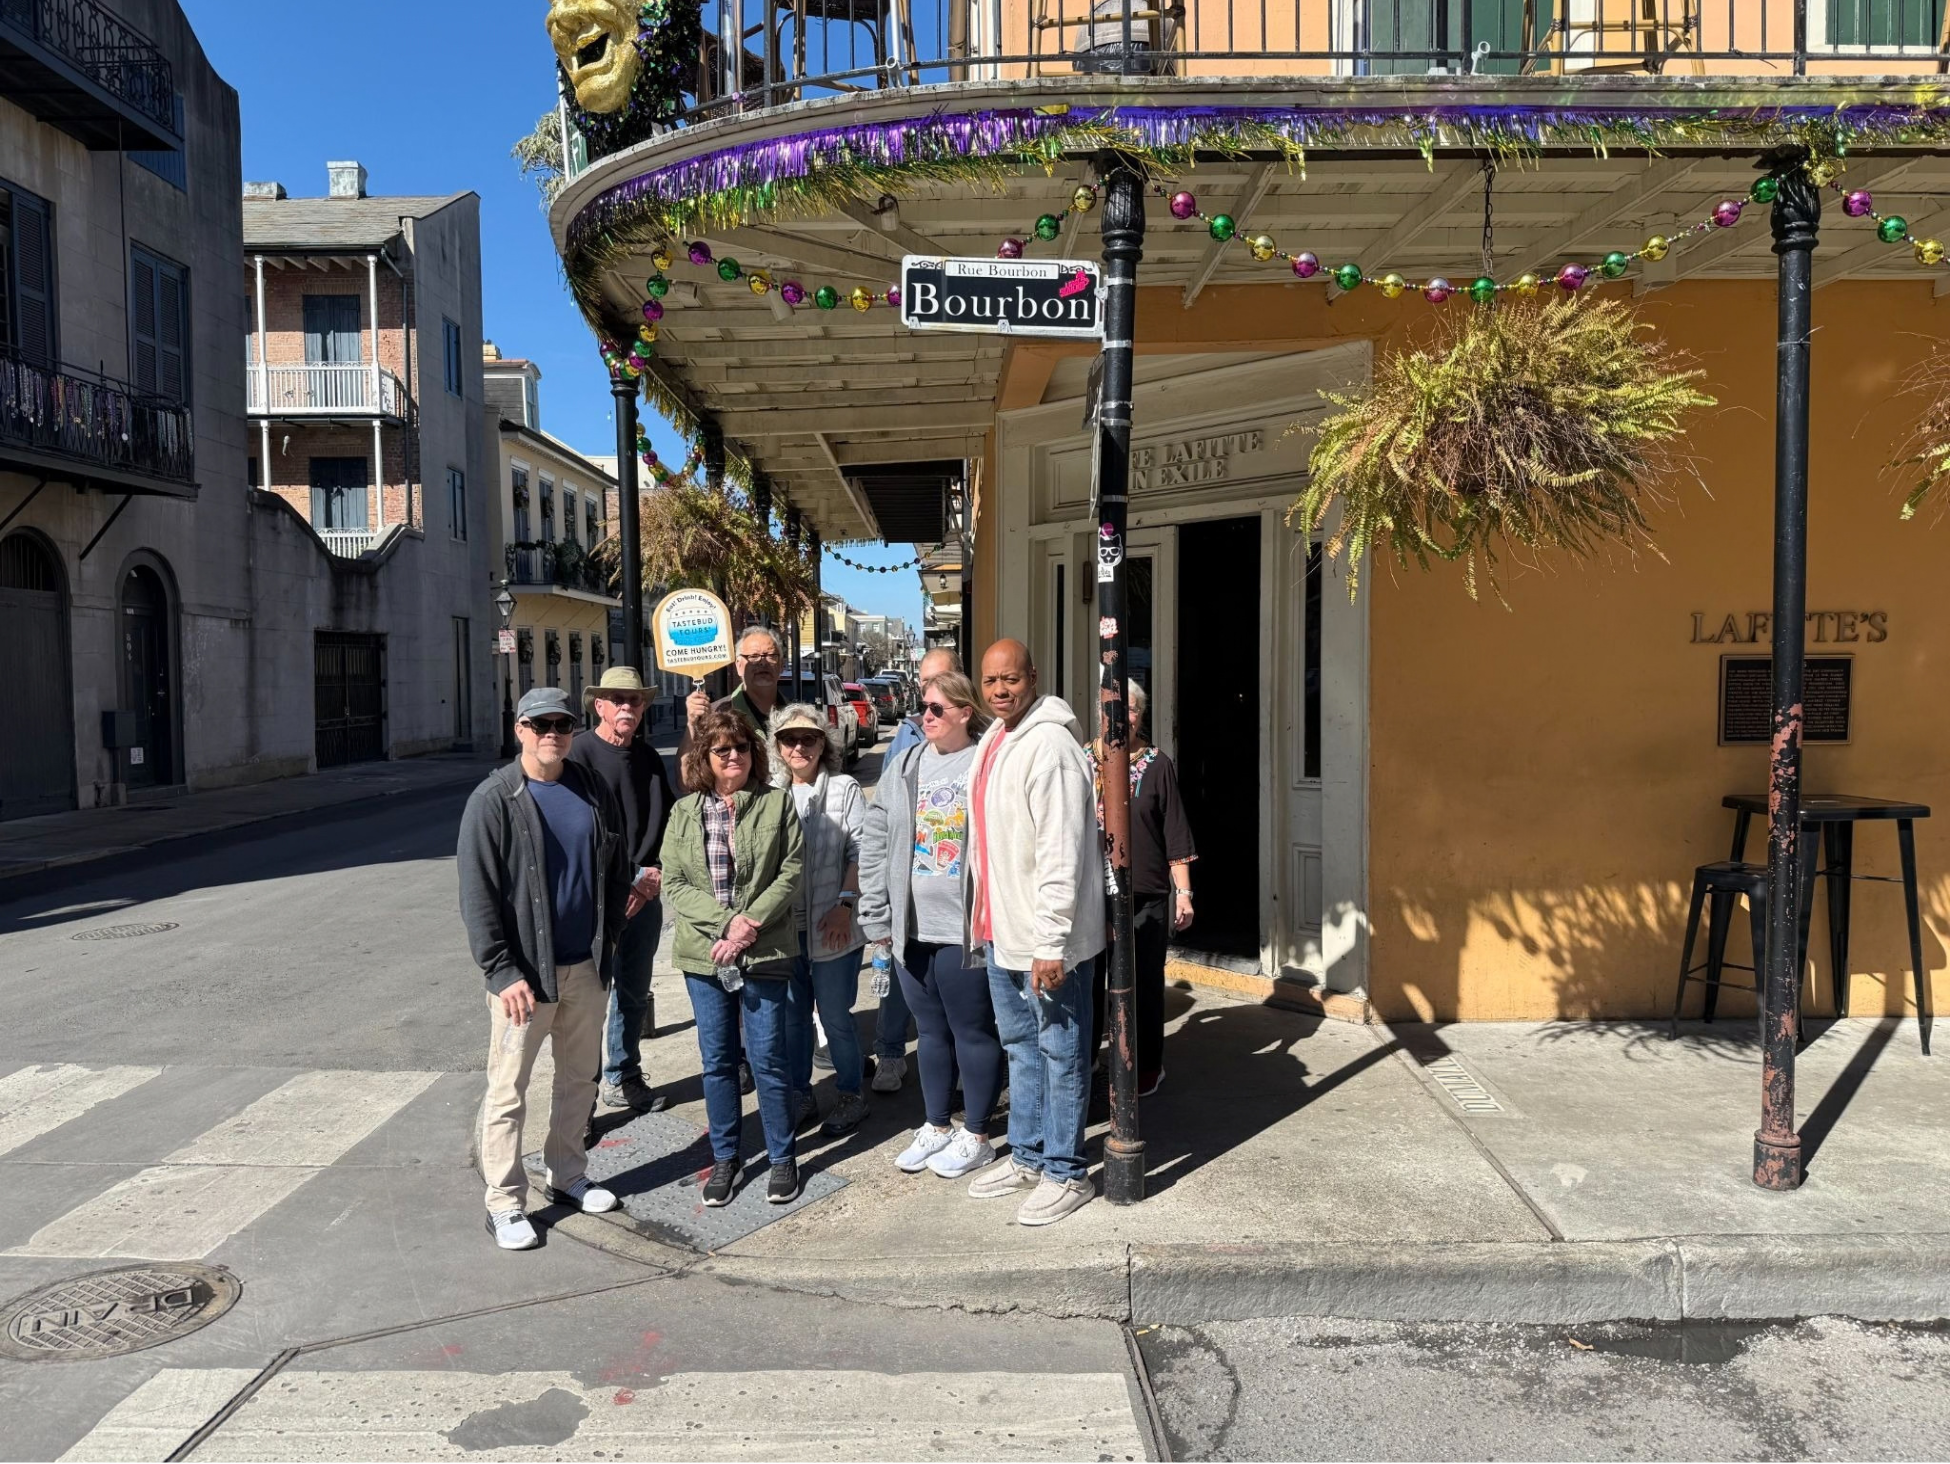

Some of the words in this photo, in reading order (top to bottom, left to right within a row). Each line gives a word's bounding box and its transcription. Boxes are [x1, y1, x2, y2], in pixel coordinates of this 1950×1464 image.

[957, 264, 983, 276] Rue
[989, 265, 1047, 278] Bourbon
[911, 282, 1091, 320] Bourbon
[1162, 430, 1262, 464] LAFITTE
[1158, 459, 1226, 486] EXILE
[672, 618, 713, 627] TASTEBUD
[1690, 611, 1889, 644] LAFTE'S
[667, 654, 727, 663] TASTEBUDTOURS.COM
[690, 645, 726, 653] HUNGRY!
[33, 1287, 193, 1333] DRAIN
